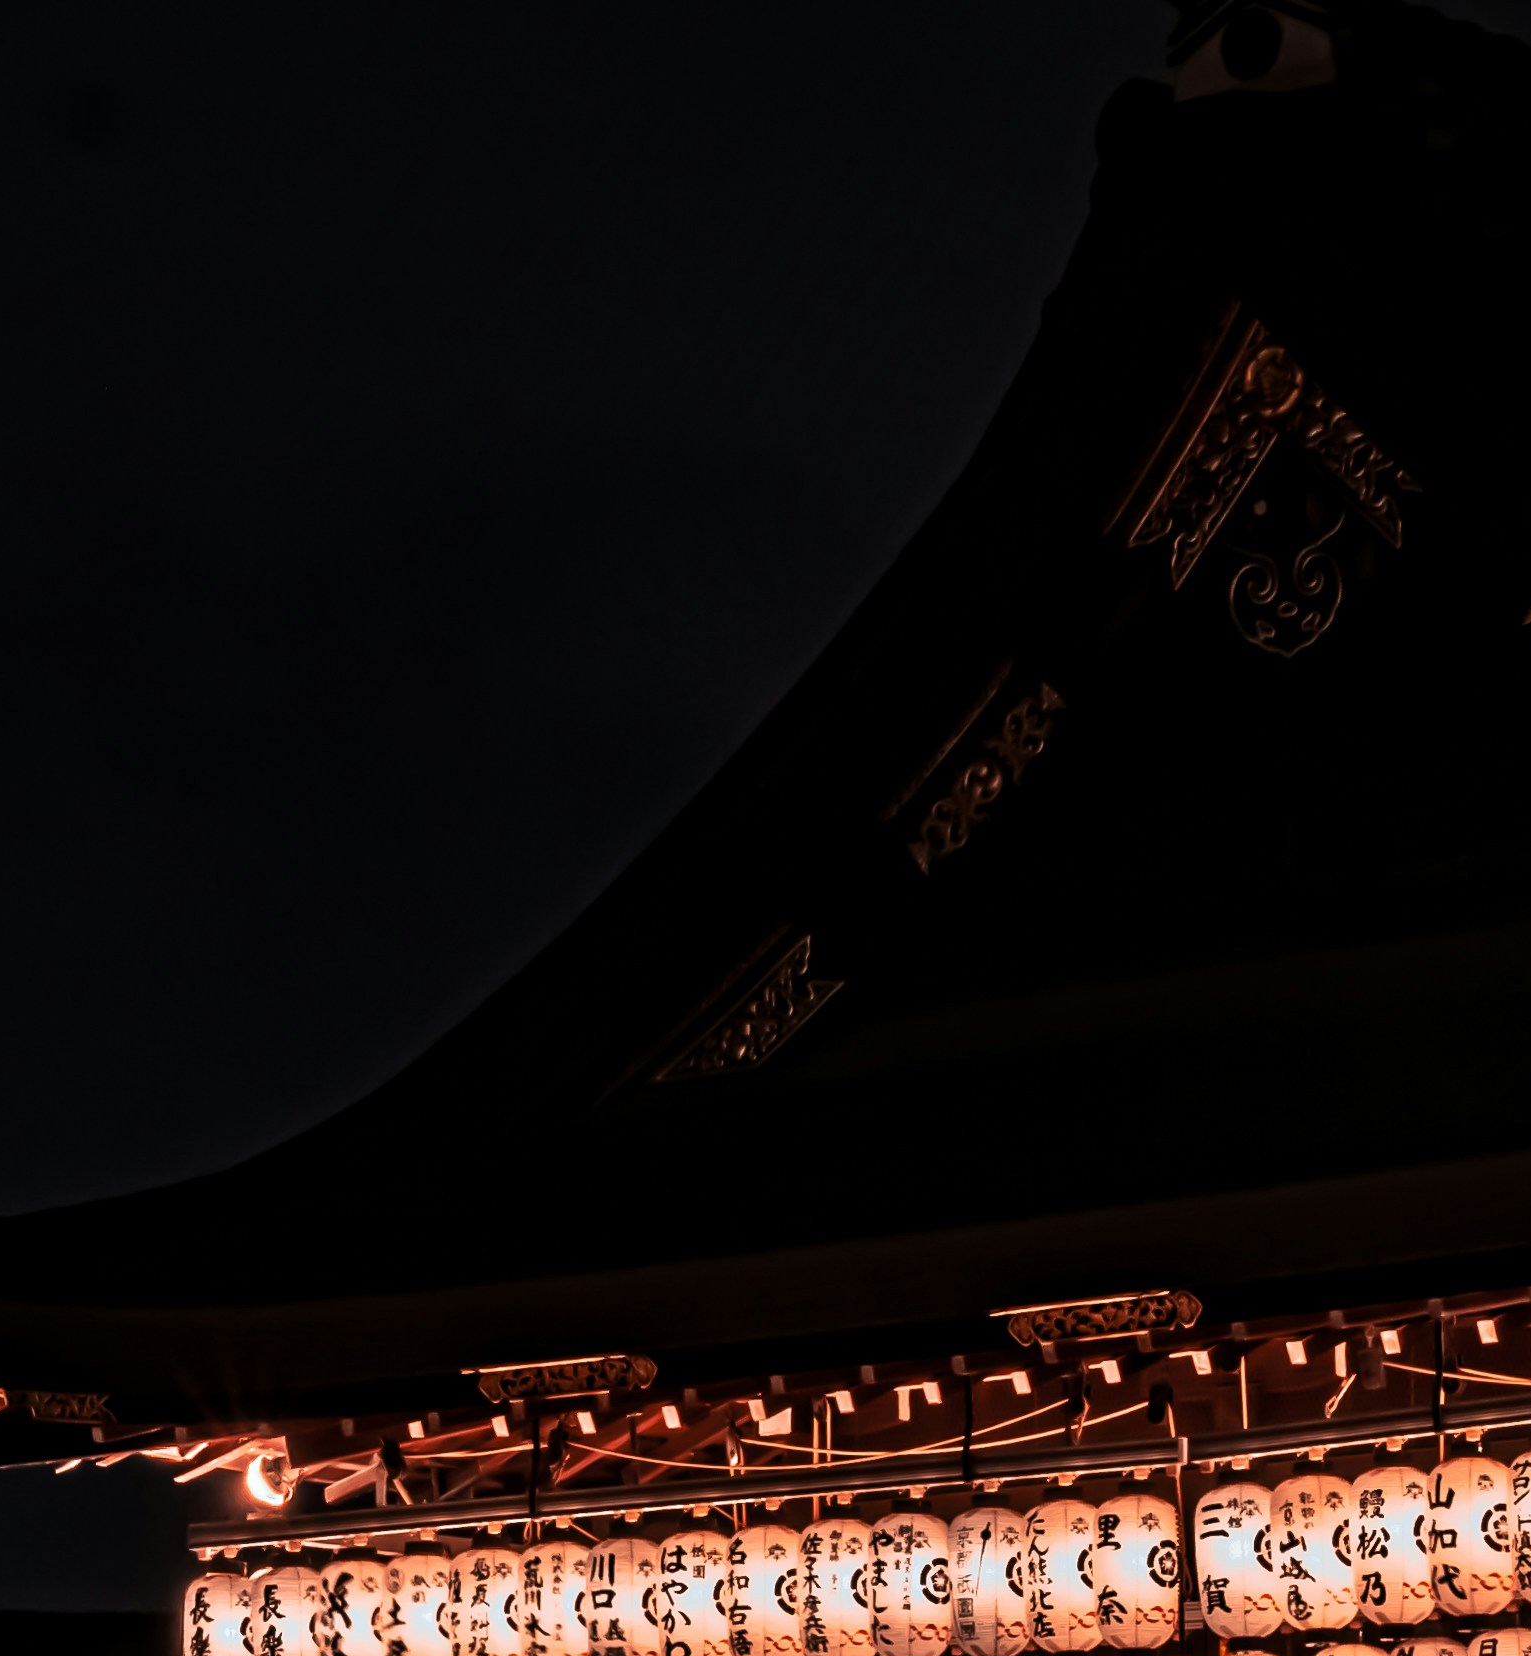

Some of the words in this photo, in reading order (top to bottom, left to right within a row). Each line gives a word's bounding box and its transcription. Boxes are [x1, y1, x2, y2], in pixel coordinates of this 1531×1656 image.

[1024, 1510, 1056, 1640] たん熊北店
[1096, 1513, 1128, 1625] 里奈
[1356, 1488, 1391, 1607] 鰻松乃
